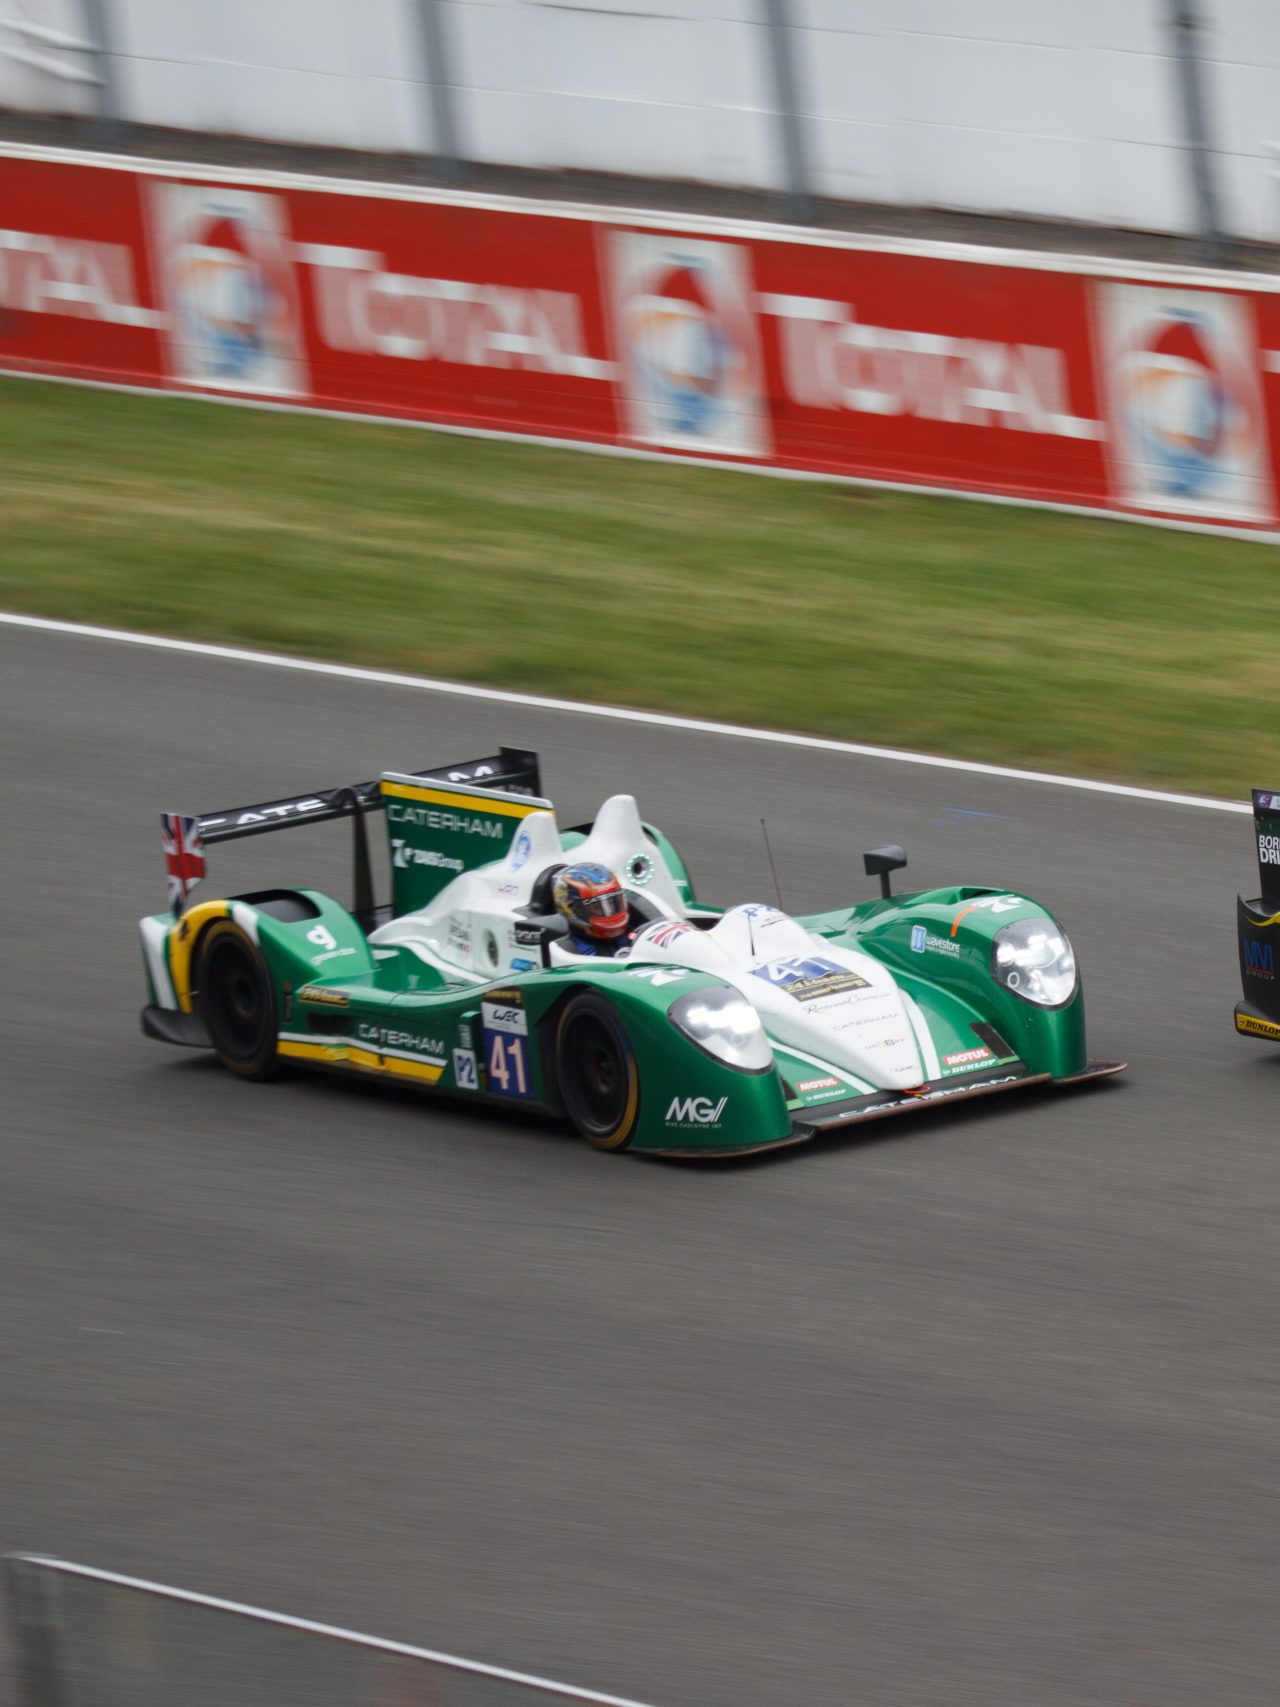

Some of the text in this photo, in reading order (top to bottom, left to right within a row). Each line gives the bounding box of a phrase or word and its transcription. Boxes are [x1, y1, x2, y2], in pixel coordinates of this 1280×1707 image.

[0, 228, 172, 331] TAL
[288, 240, 618, 382] TOTAL
[759, 292, 1106, 441] TOTAL
[387, 804, 503, 839] CATERHAM
[358, 1023, 445, 1054] CATERHAM
[1245, 1020, 1280, 1036] DUNLOP
[456, 1055, 476, 1084] P2
[490, 1035, 527, 1093] 41
[946, 1049, 988, 1065] MOTUL
[951, 1059, 995, 1073] DUNLOP
[800, 1078, 838, 1091] MOTUL
